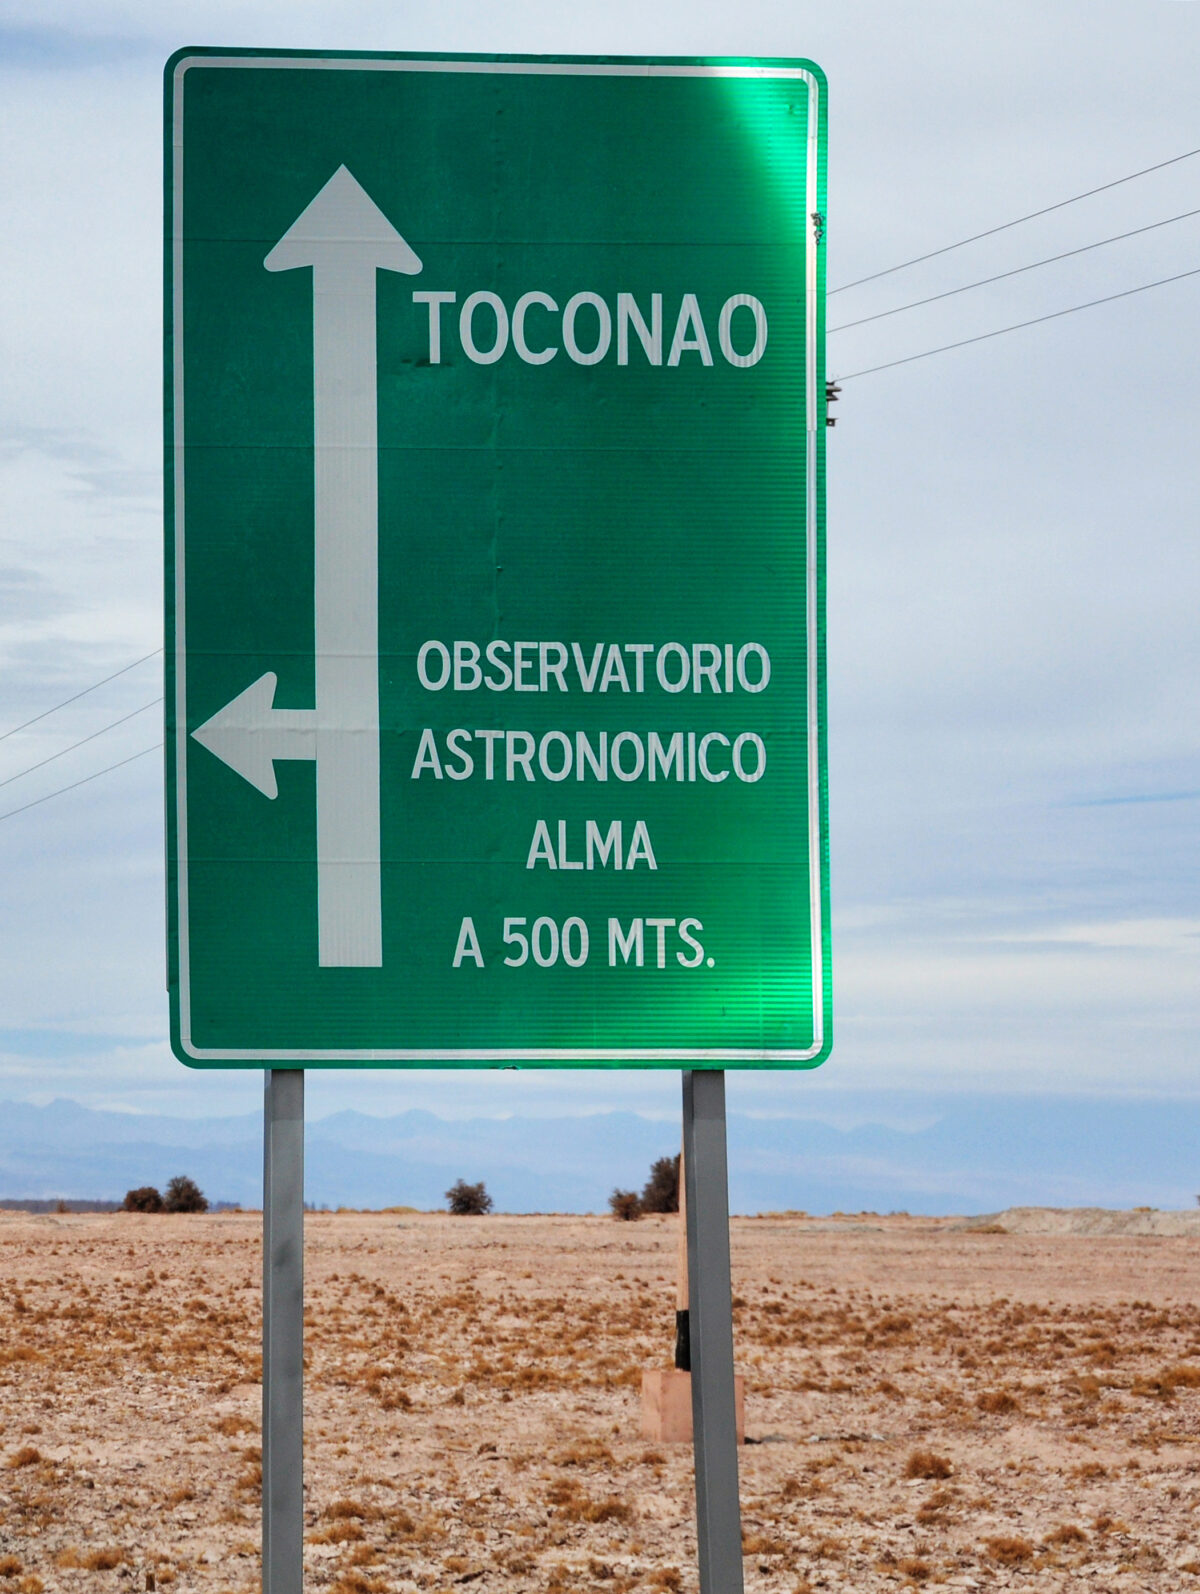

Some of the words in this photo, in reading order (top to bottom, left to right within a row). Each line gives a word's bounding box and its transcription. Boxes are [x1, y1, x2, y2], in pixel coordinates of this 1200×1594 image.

[412, 290, 768, 369] TOCONAO
[416, 639, 771, 694] OBSERVATORIO
[411, 728, 767, 783] ASTRONOMICO
[526, 819, 658, 871] ALMA
[452, 917, 484, 968] A
[502, 916, 590, 967] 500
[608, 917, 716, 969] MTS.
